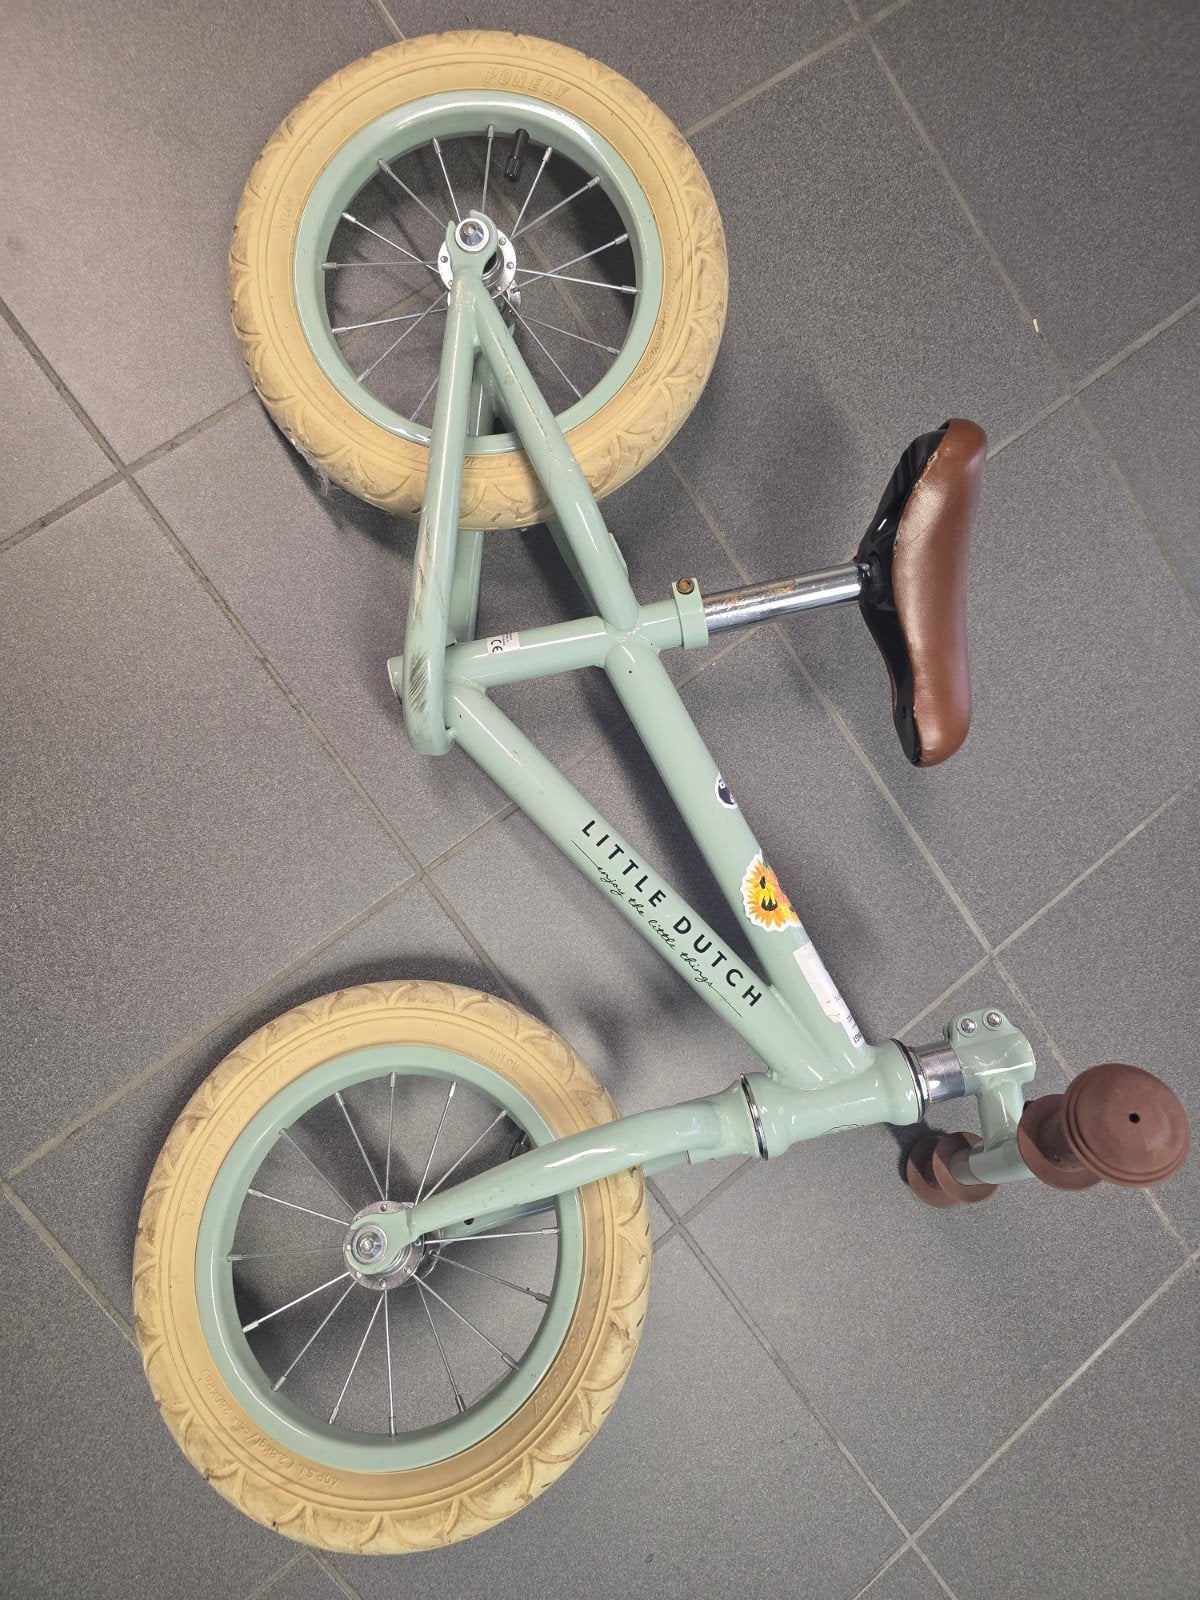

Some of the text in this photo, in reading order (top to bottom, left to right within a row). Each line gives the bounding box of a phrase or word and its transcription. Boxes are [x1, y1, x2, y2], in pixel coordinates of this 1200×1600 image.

[482, 67, 570, 101] PONELY
[490, 639, 504, 653] CE
[581, 820, 763, 1007] LITTLE DUTCH
[597, 866, 714, 987] enjoy the little things
